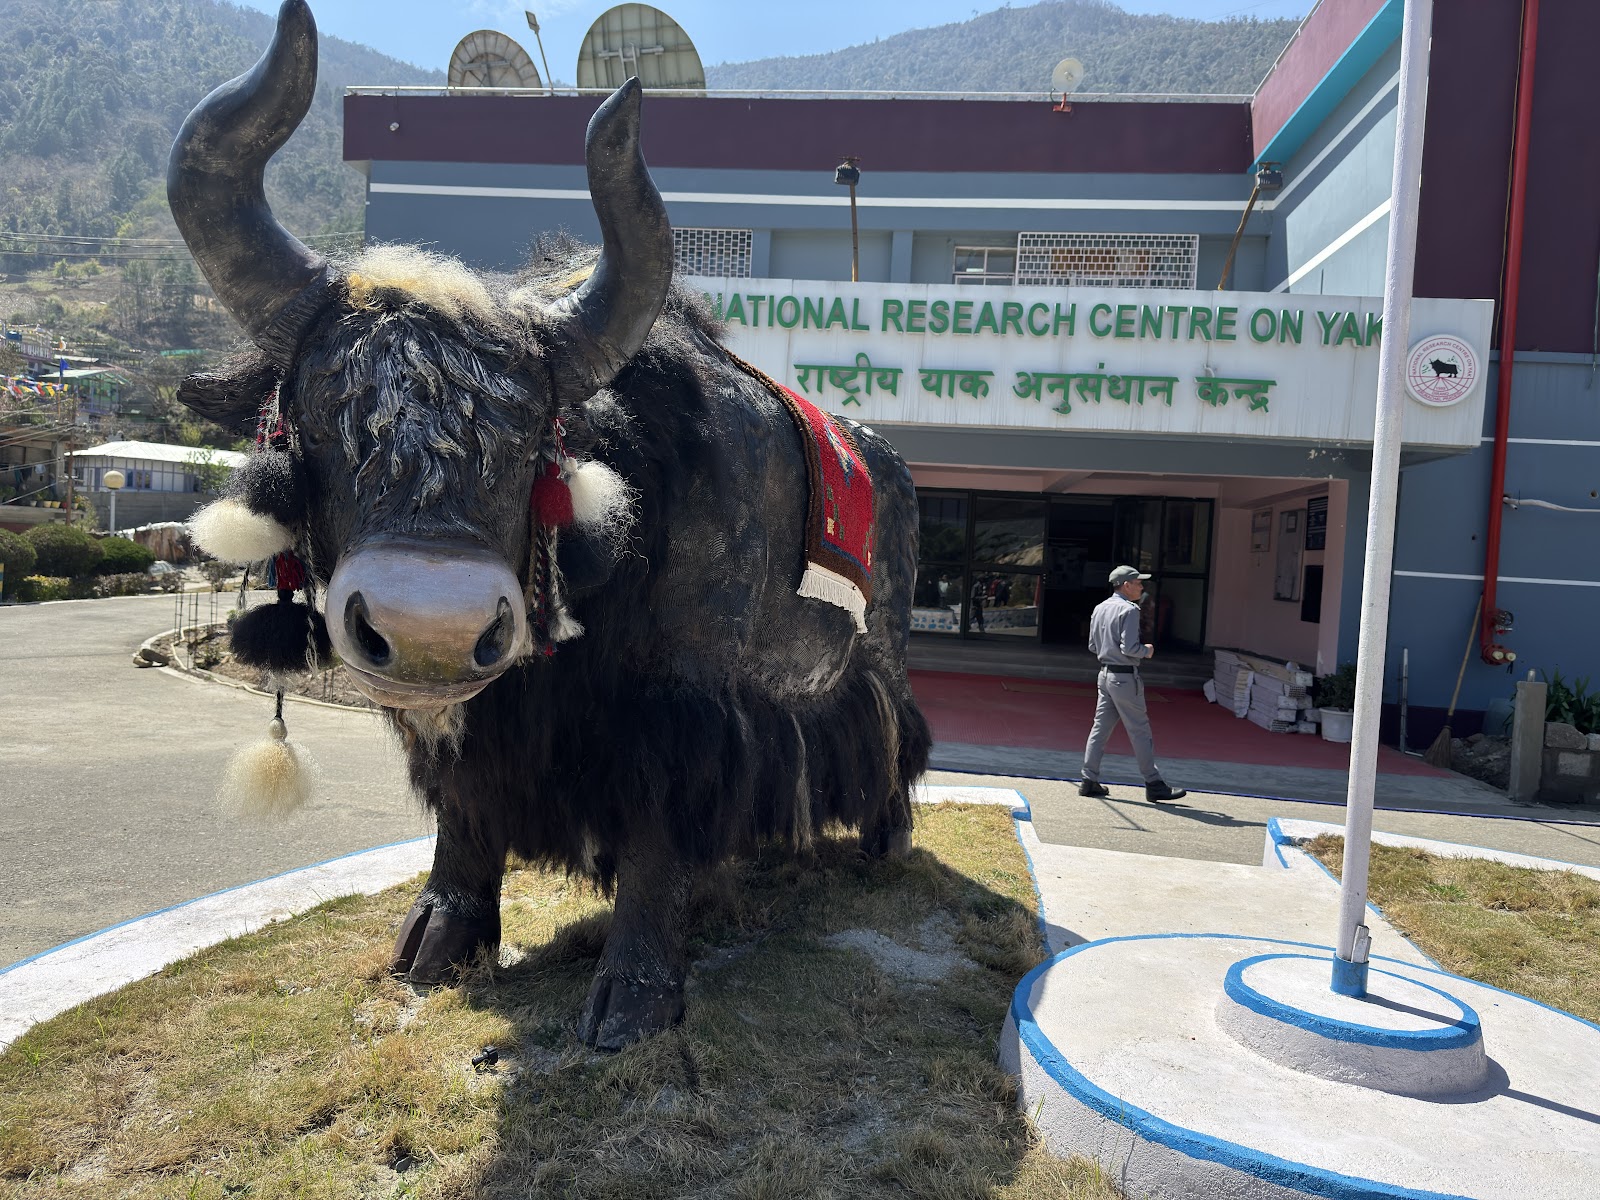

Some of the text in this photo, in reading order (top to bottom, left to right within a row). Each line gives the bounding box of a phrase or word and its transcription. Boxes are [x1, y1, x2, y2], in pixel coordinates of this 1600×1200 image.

[882, 300, 1076, 336] RESEARCH
[1089, 303, 1238, 341] CENTRE
[1250, 308, 1303, 343] ON
[1423, 341, 1452, 352] RESEARCH
[1452, 343, 1469, 358] CENTRE
[793, 353, 1276, 415] राष्ट्रीय याक अनुसंधान केन्द्र
